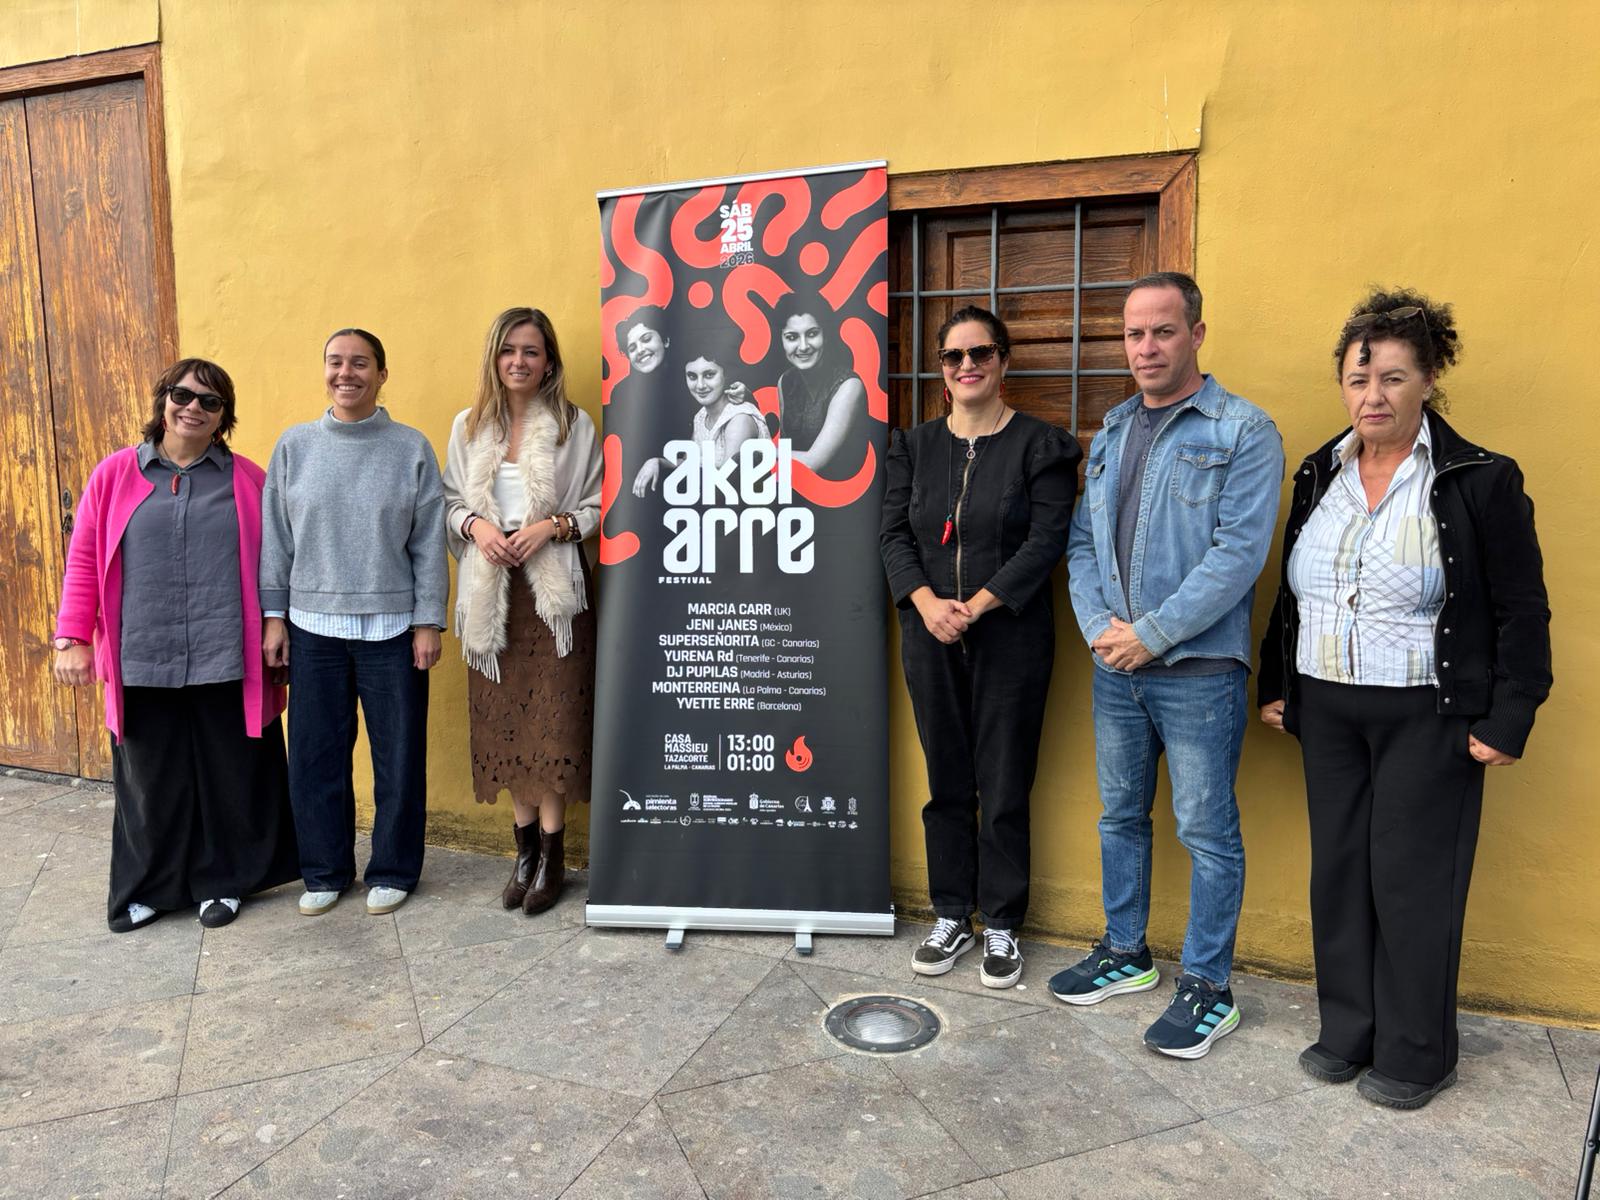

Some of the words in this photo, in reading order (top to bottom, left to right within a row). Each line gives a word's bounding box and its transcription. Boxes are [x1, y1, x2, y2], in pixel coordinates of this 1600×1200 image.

[720, 199, 752, 219] SÁB
[720, 216, 754, 243] 25
[720, 241, 754, 254] ABRIL
[720, 252, 755, 269] 2026
[663, 438, 792, 505] akel
[663, 507, 814, 573] arre
[688, 603, 736, 614] MARCIA
[739, 604, 771, 615] CARR
[774, 608, 790, 616] (UK)
[686, 619, 714, 630] JENI
[717, 619, 757, 630] JANES
[760, 623, 792, 632] (México)
[659, 632, 760, 647] SUPERSEÑORITA
[762, 639, 775, 647] (GC
[782, 639, 819, 648] Canarias)
[664, 650, 714, 661] YURENA
[718, 650, 733, 662] Rd
[736, 654, 770, 663] (Tenerife
[777, 655, 814, 664] Canarias)
[667, 666, 683, 677] DJ
[687, 666, 738, 677] PUPILAS
[741, 670, 770, 678] (Madrid
[777, 671, 811, 679] Asturias)
[653, 682, 740, 693] MONTERREINA
[743, 686, 755, 694] (La
[757, 686, 781, 694] Palma
[789, 687, 826, 696] Canarias)
[677, 698, 720, 709] YVETTE
[724, 698, 754, 709] ERRE
[757, 702, 801, 711] (Barcelona)
[665, 734, 691, 744] CASA
[727, 735, 774, 752] 13:00
[665, 743, 708, 753] MASSIEU
[727, 754, 774, 771] 01:00
